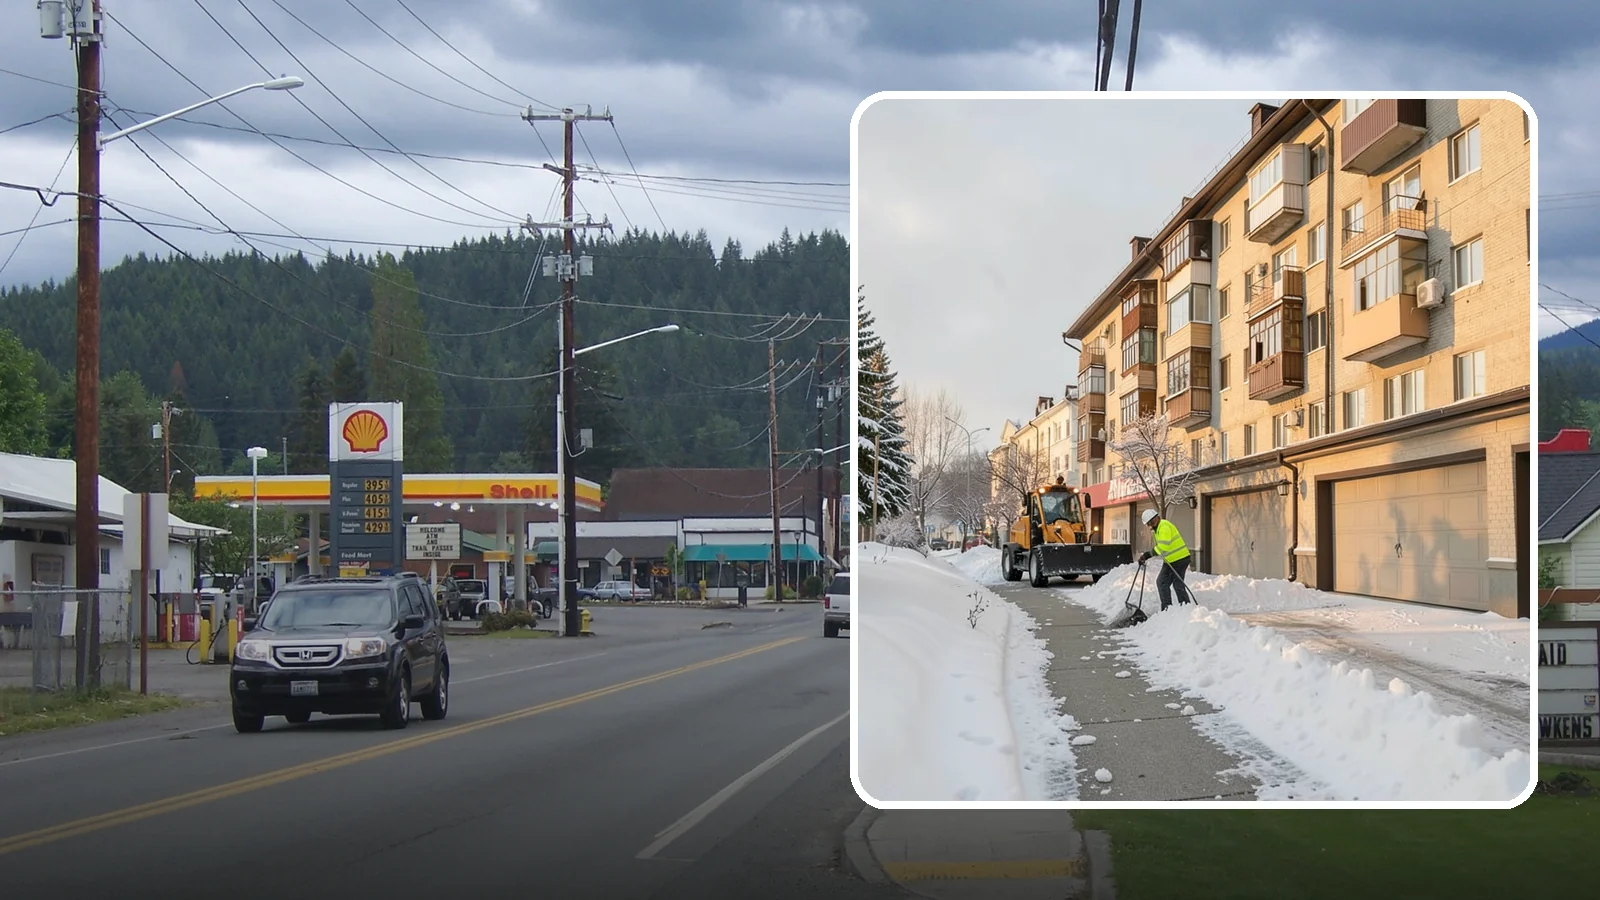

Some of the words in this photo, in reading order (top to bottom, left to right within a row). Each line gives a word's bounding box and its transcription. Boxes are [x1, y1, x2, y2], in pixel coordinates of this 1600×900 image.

[365, 480, 384, 490] 395
[490, 484, 547, 499] Shell
[365, 494, 384, 504] 405
[365, 508, 383, 518] 415
[365, 522, 384, 533] 429
[1538, 642, 1567, 665] AID
[1539, 716, 1592, 739] WKENS
